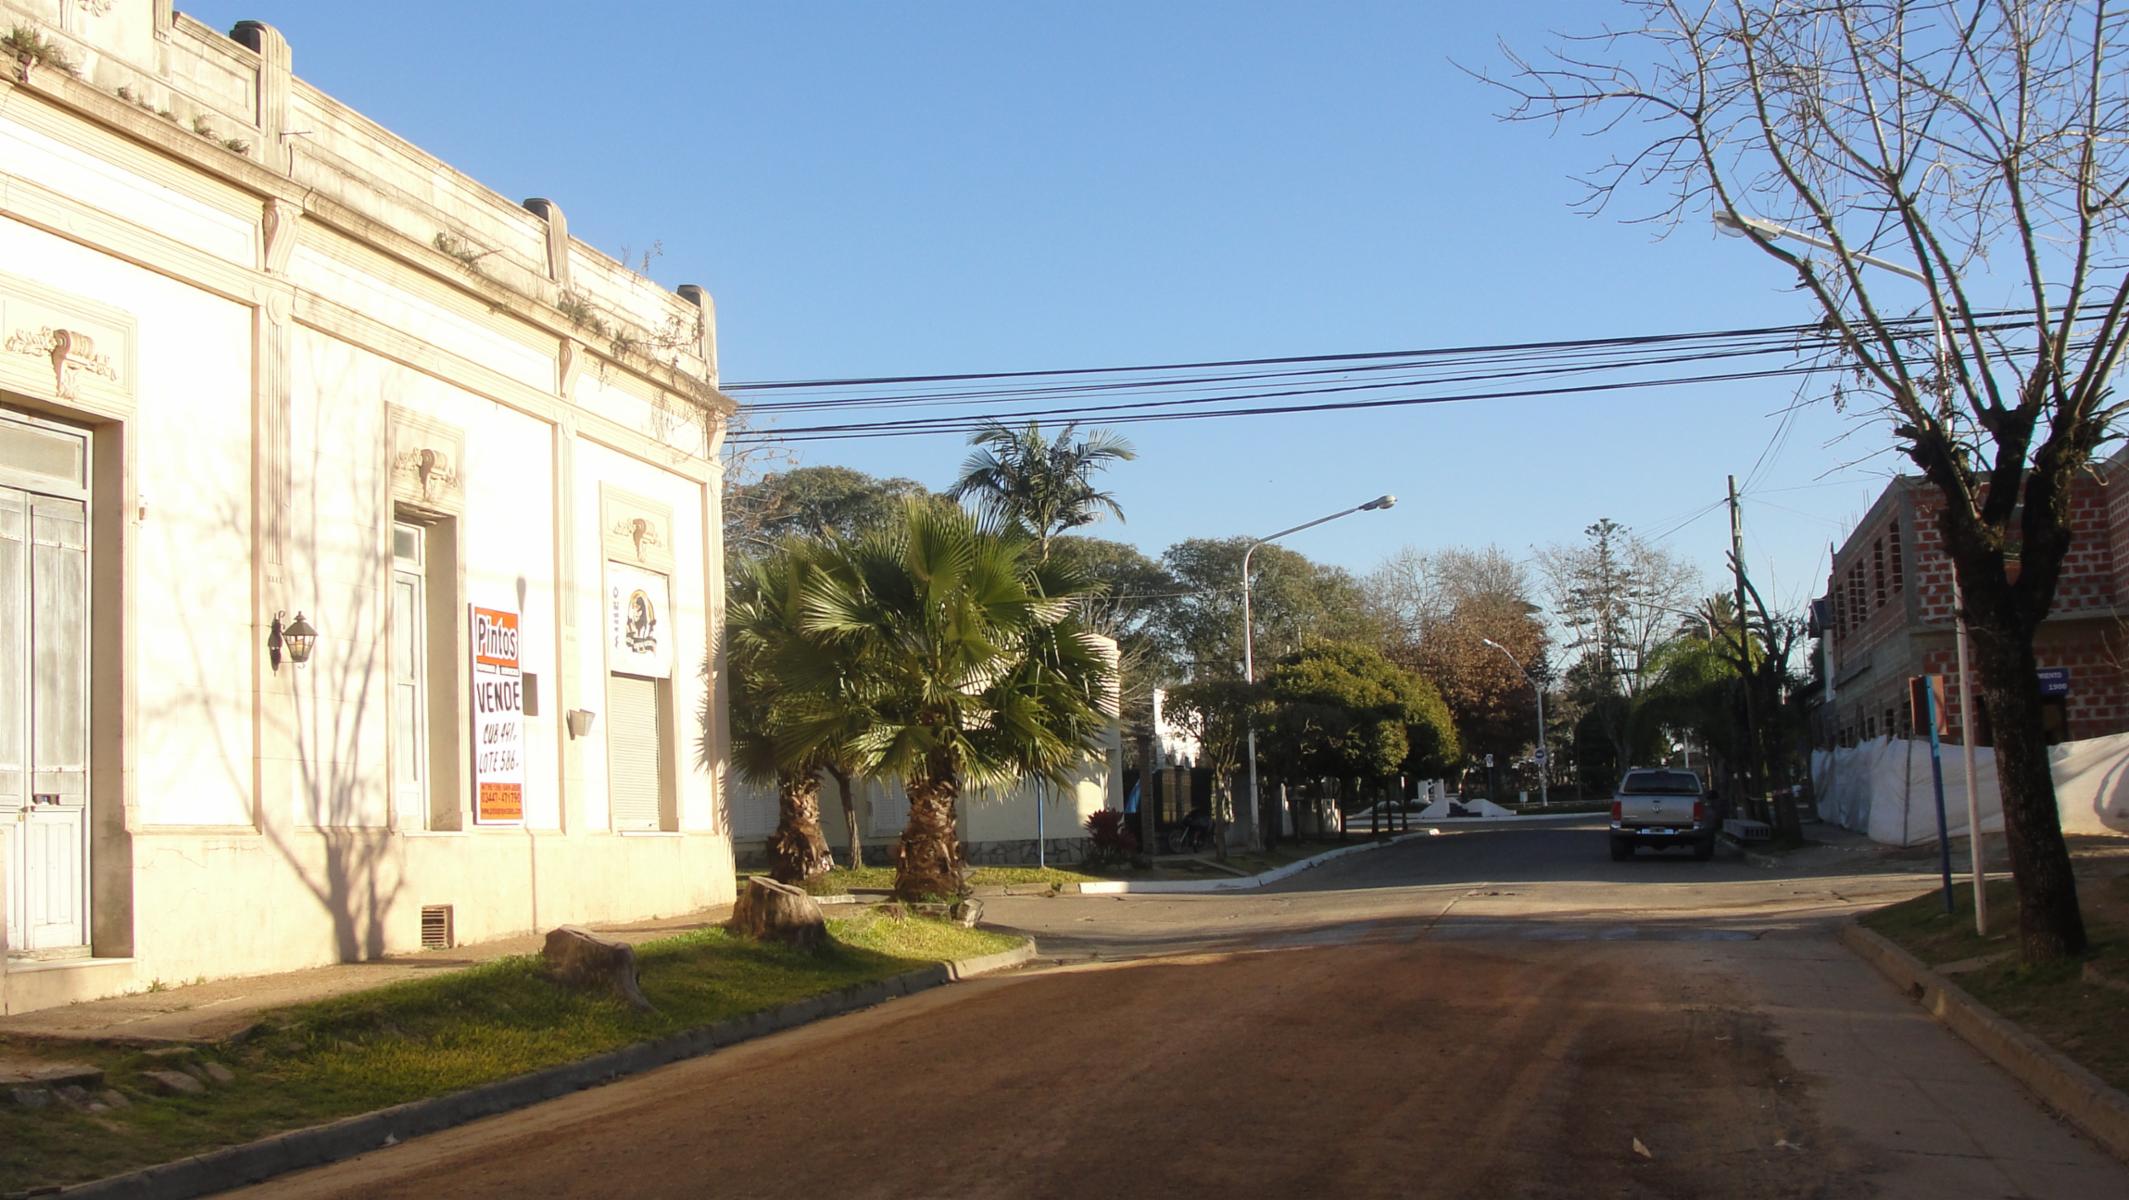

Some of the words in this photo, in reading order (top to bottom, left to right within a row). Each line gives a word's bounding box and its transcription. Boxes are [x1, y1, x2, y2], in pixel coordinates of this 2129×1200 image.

[478, 616, 516, 659] Pintos
[476, 681, 521, 714] VENDE
[479, 752, 499, 774] LOTE
